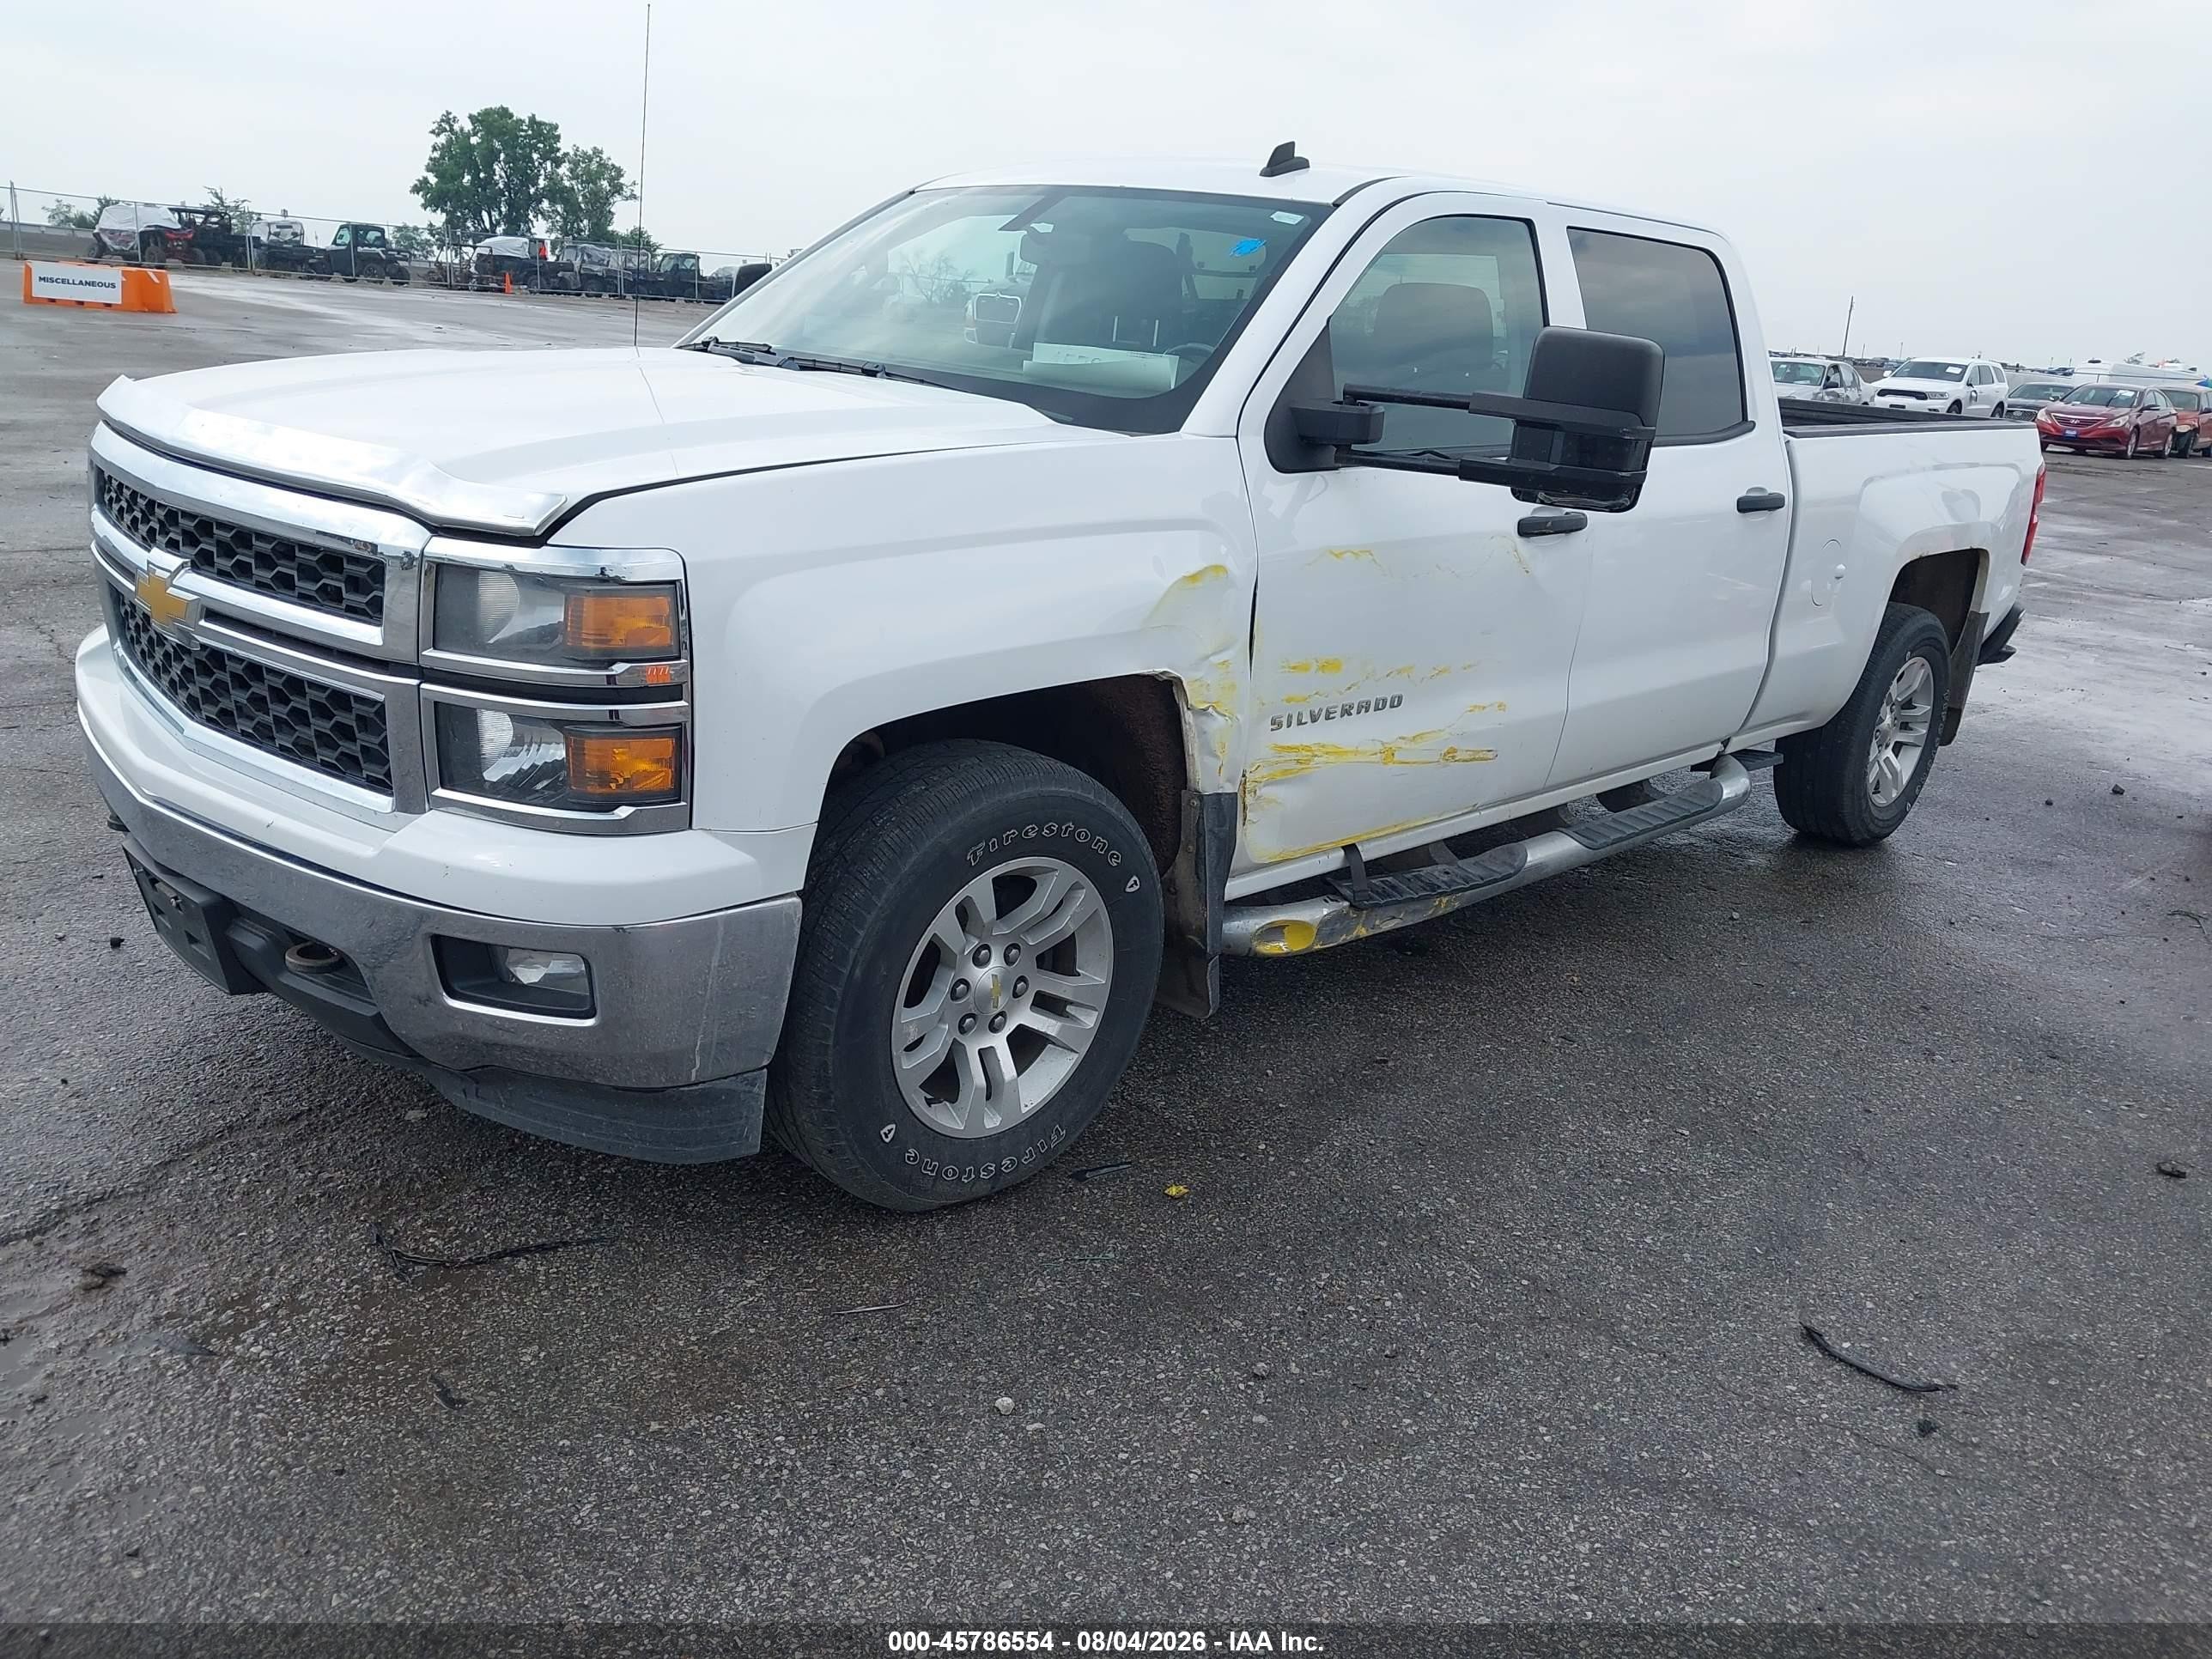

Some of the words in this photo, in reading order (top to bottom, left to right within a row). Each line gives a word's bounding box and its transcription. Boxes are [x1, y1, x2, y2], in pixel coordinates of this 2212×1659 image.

[39, 276, 117, 289] MISCELLANEOUS
[1270, 693, 1404, 732] SILVERADO
[967, 821, 1121, 866] Firestone
[904, 1124, 1066, 1183] Firestone
